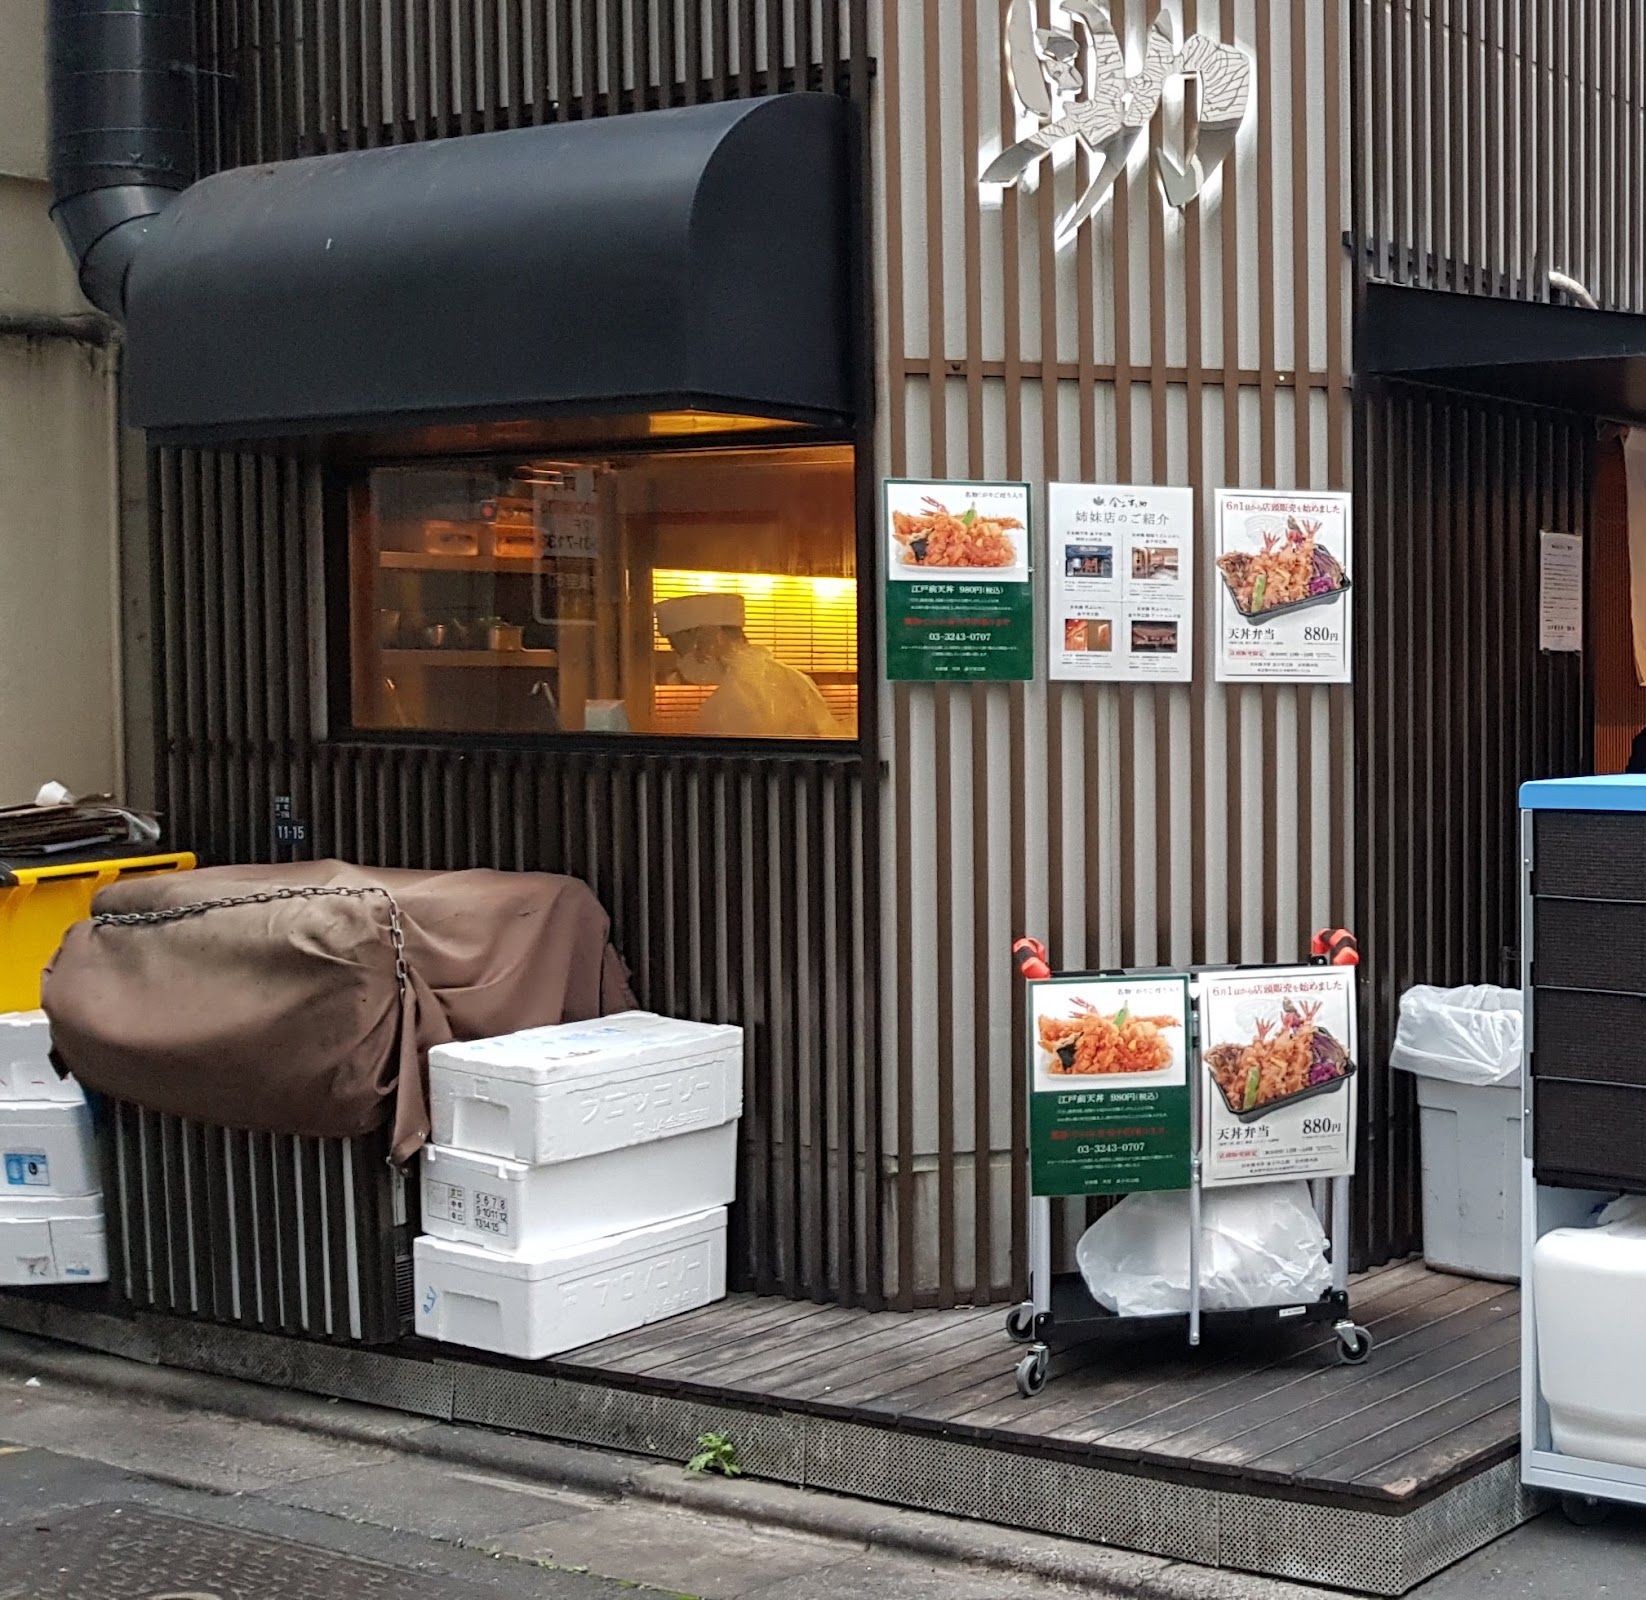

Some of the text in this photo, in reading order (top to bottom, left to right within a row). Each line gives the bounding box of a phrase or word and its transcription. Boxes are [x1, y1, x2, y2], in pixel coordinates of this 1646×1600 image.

[1075, 511, 1169, 525] 姉妹店のご紹介
[928, 632, 991, 641] 03-3243-0707
[1228, 626, 1338, 641] 天丼弁当 880円
[278, 825, 305, 840] 11-15
[1217, 1117, 1341, 1140] 天丼弁当 880円
[1077, 1142, 1145, 1154] 03-3243-0707
